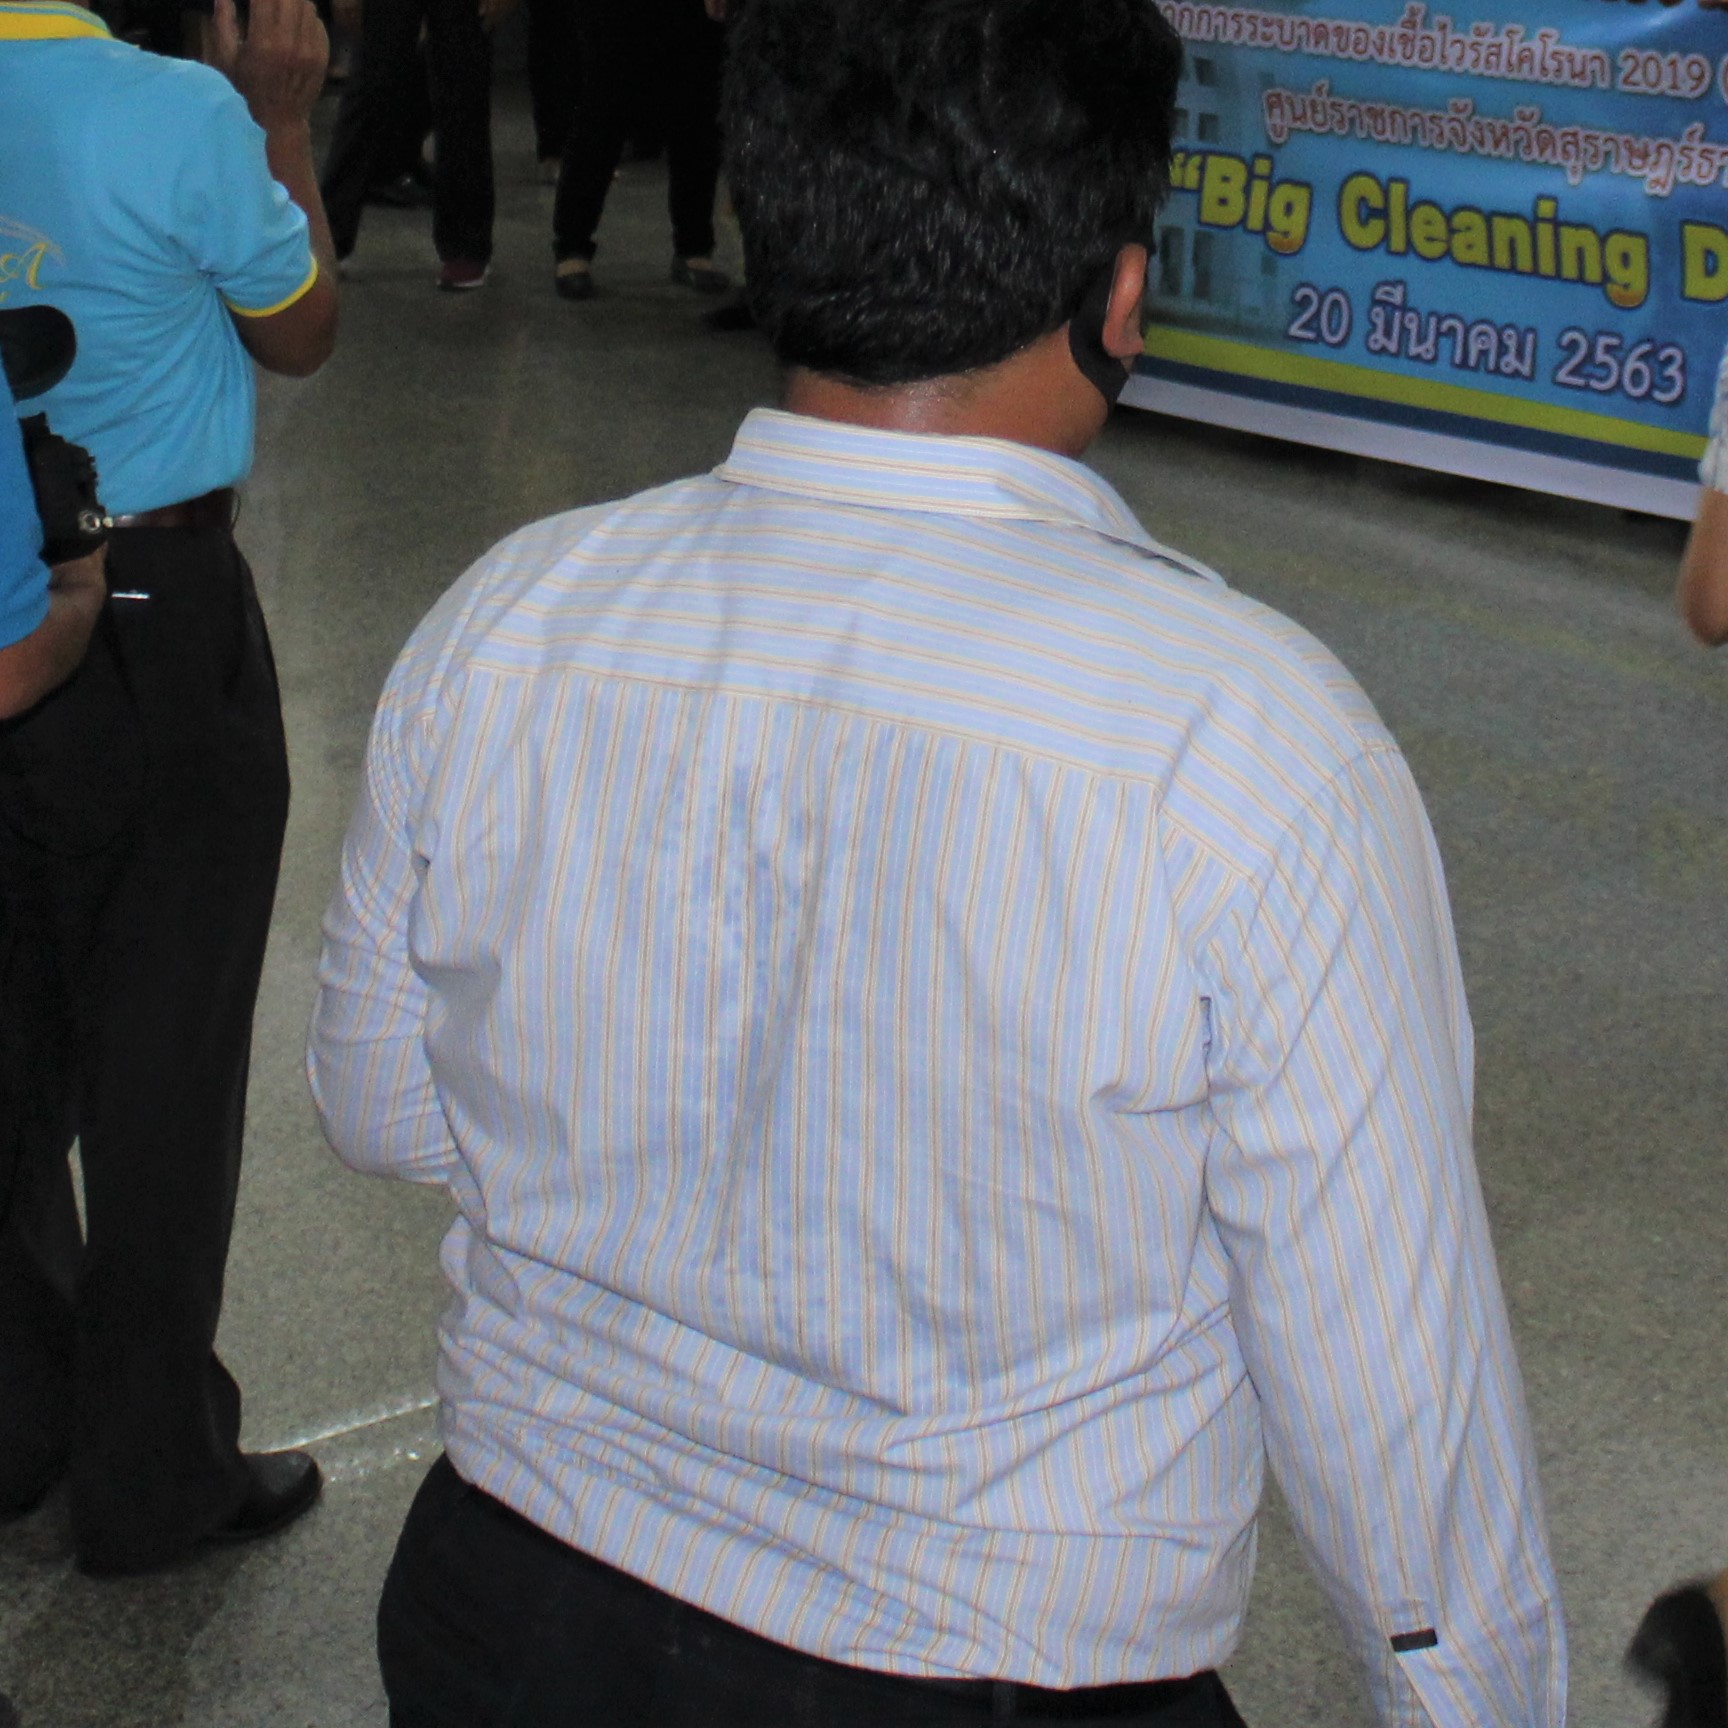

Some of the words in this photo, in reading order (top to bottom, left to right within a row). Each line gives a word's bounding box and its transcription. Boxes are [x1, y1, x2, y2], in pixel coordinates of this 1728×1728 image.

[1156, 2, 1610, 90] ากการระบาดของเชื้อไวรัสโคโรนา
[1620, 50, 1710, 98] 2019
[1338, 170, 1650, 309] Cleaning
[1288, 284, 1350, 346] 20
[1367, 281, 1537, 378] มีนาคม
[1555, 330, 1685, 404] 2563
